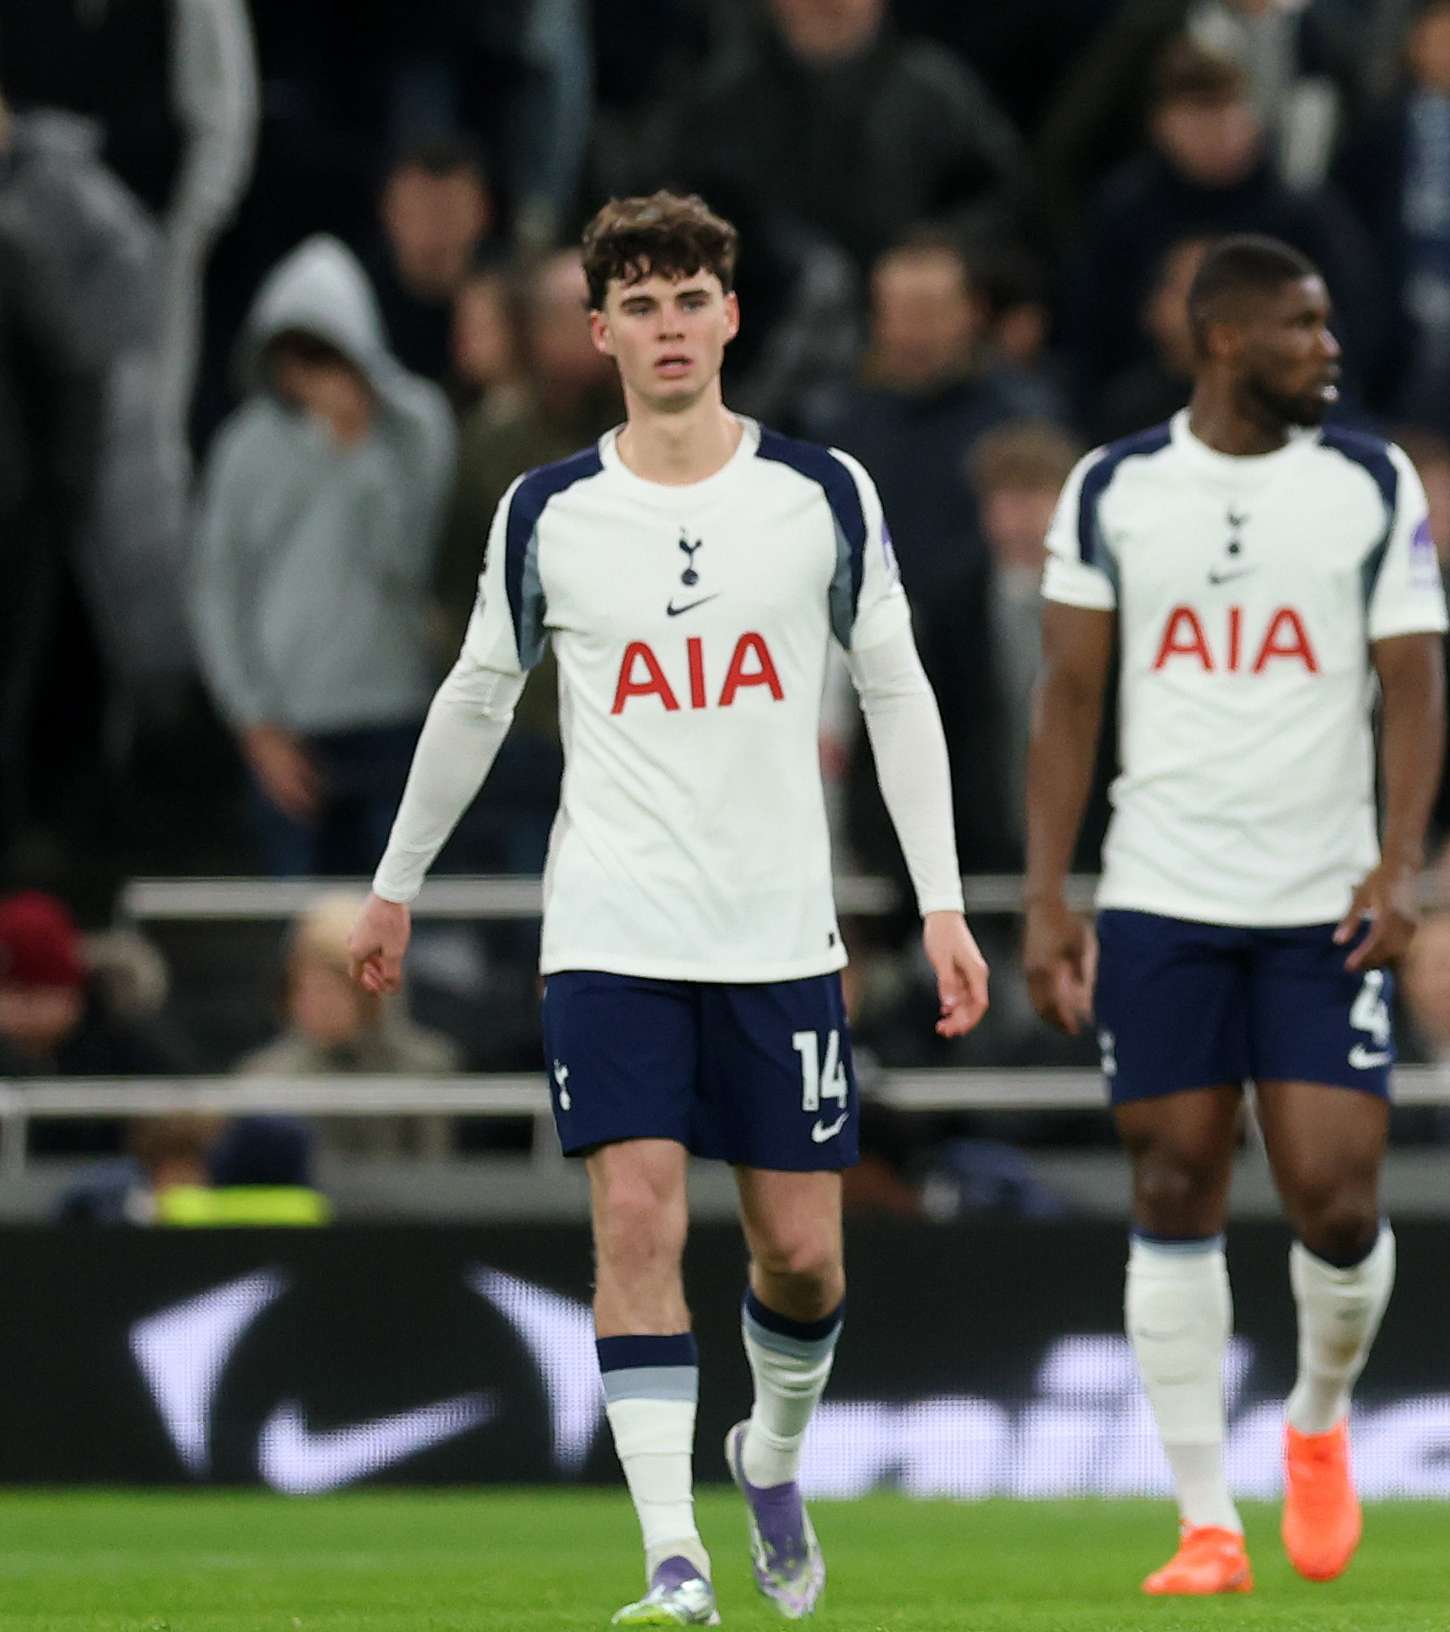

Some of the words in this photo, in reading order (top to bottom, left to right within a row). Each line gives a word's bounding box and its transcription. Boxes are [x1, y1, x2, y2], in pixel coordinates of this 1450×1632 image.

[611, 631, 784, 716] AIA
[1153, 606, 1319, 674] AIA
[1349, 968, 1390, 1047] 4
[792, 1029, 848, 1111] 14
